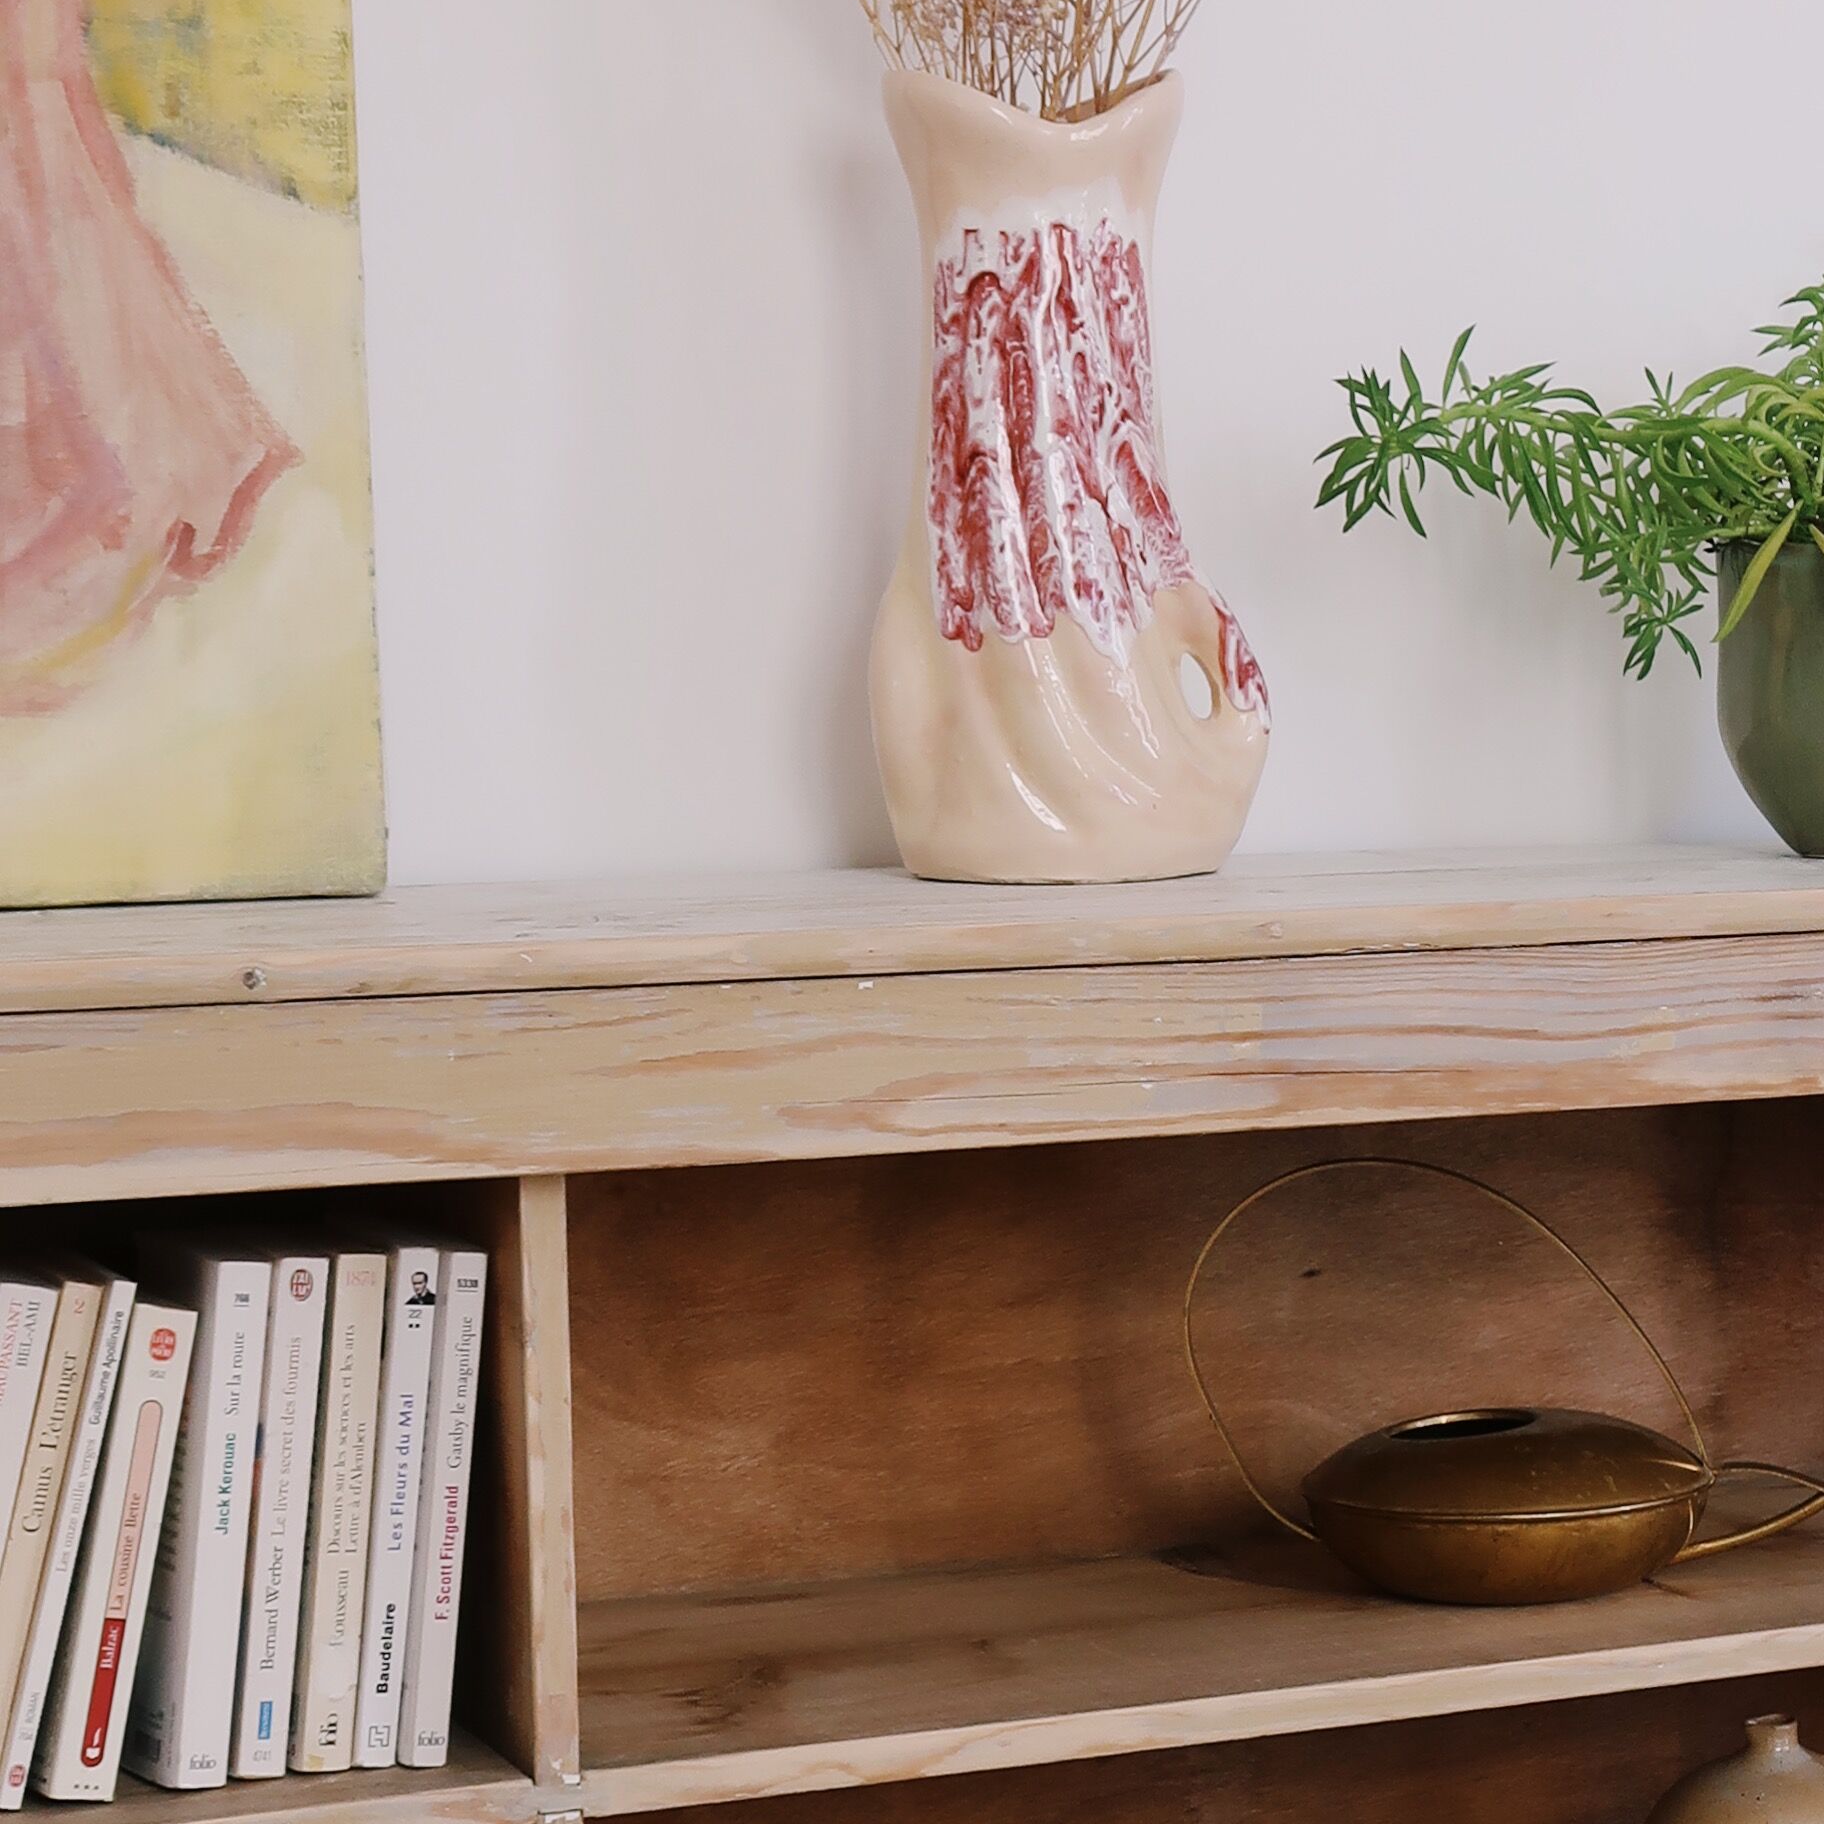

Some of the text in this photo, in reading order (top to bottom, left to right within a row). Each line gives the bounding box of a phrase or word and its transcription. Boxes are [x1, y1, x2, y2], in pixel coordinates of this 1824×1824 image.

[16, 1301, 40, 1367] BEL-AMI
[88, 1311, 124, 1425] Guillaume Apollinaire
[224, 1332, 245, 1416] Sur la route
[270, 1336, 303, 1537] Le livre secret des fourmis
[327, 1324, 356, 1554] Discours sur les sciences et les arts
[446, 1316, 475, 1468] Gatsby le magnifique
[21, 1466, 53, 1533] Camus
[56, 1439, 96, 1572] Les onze mille verges
[214, 1433, 236, 1536] Jack Kerouac
[389, 1393, 414, 1551] Les Fleurs du Mal
[110, 1493, 141, 1611] La cousine Bette
[344, 1513, 359, 1554] Lettre
[434, 1485, 459, 1620] F. Scott Fitzgerald
[99, 1625, 119, 1669] Balzac
[259, 1546, 284, 1670] Bernard Werber
[376, 1603, 396, 1693] Baudelaire
[188, 1754, 217, 1769] folio
[417, 1731, 445, 1747] folio
